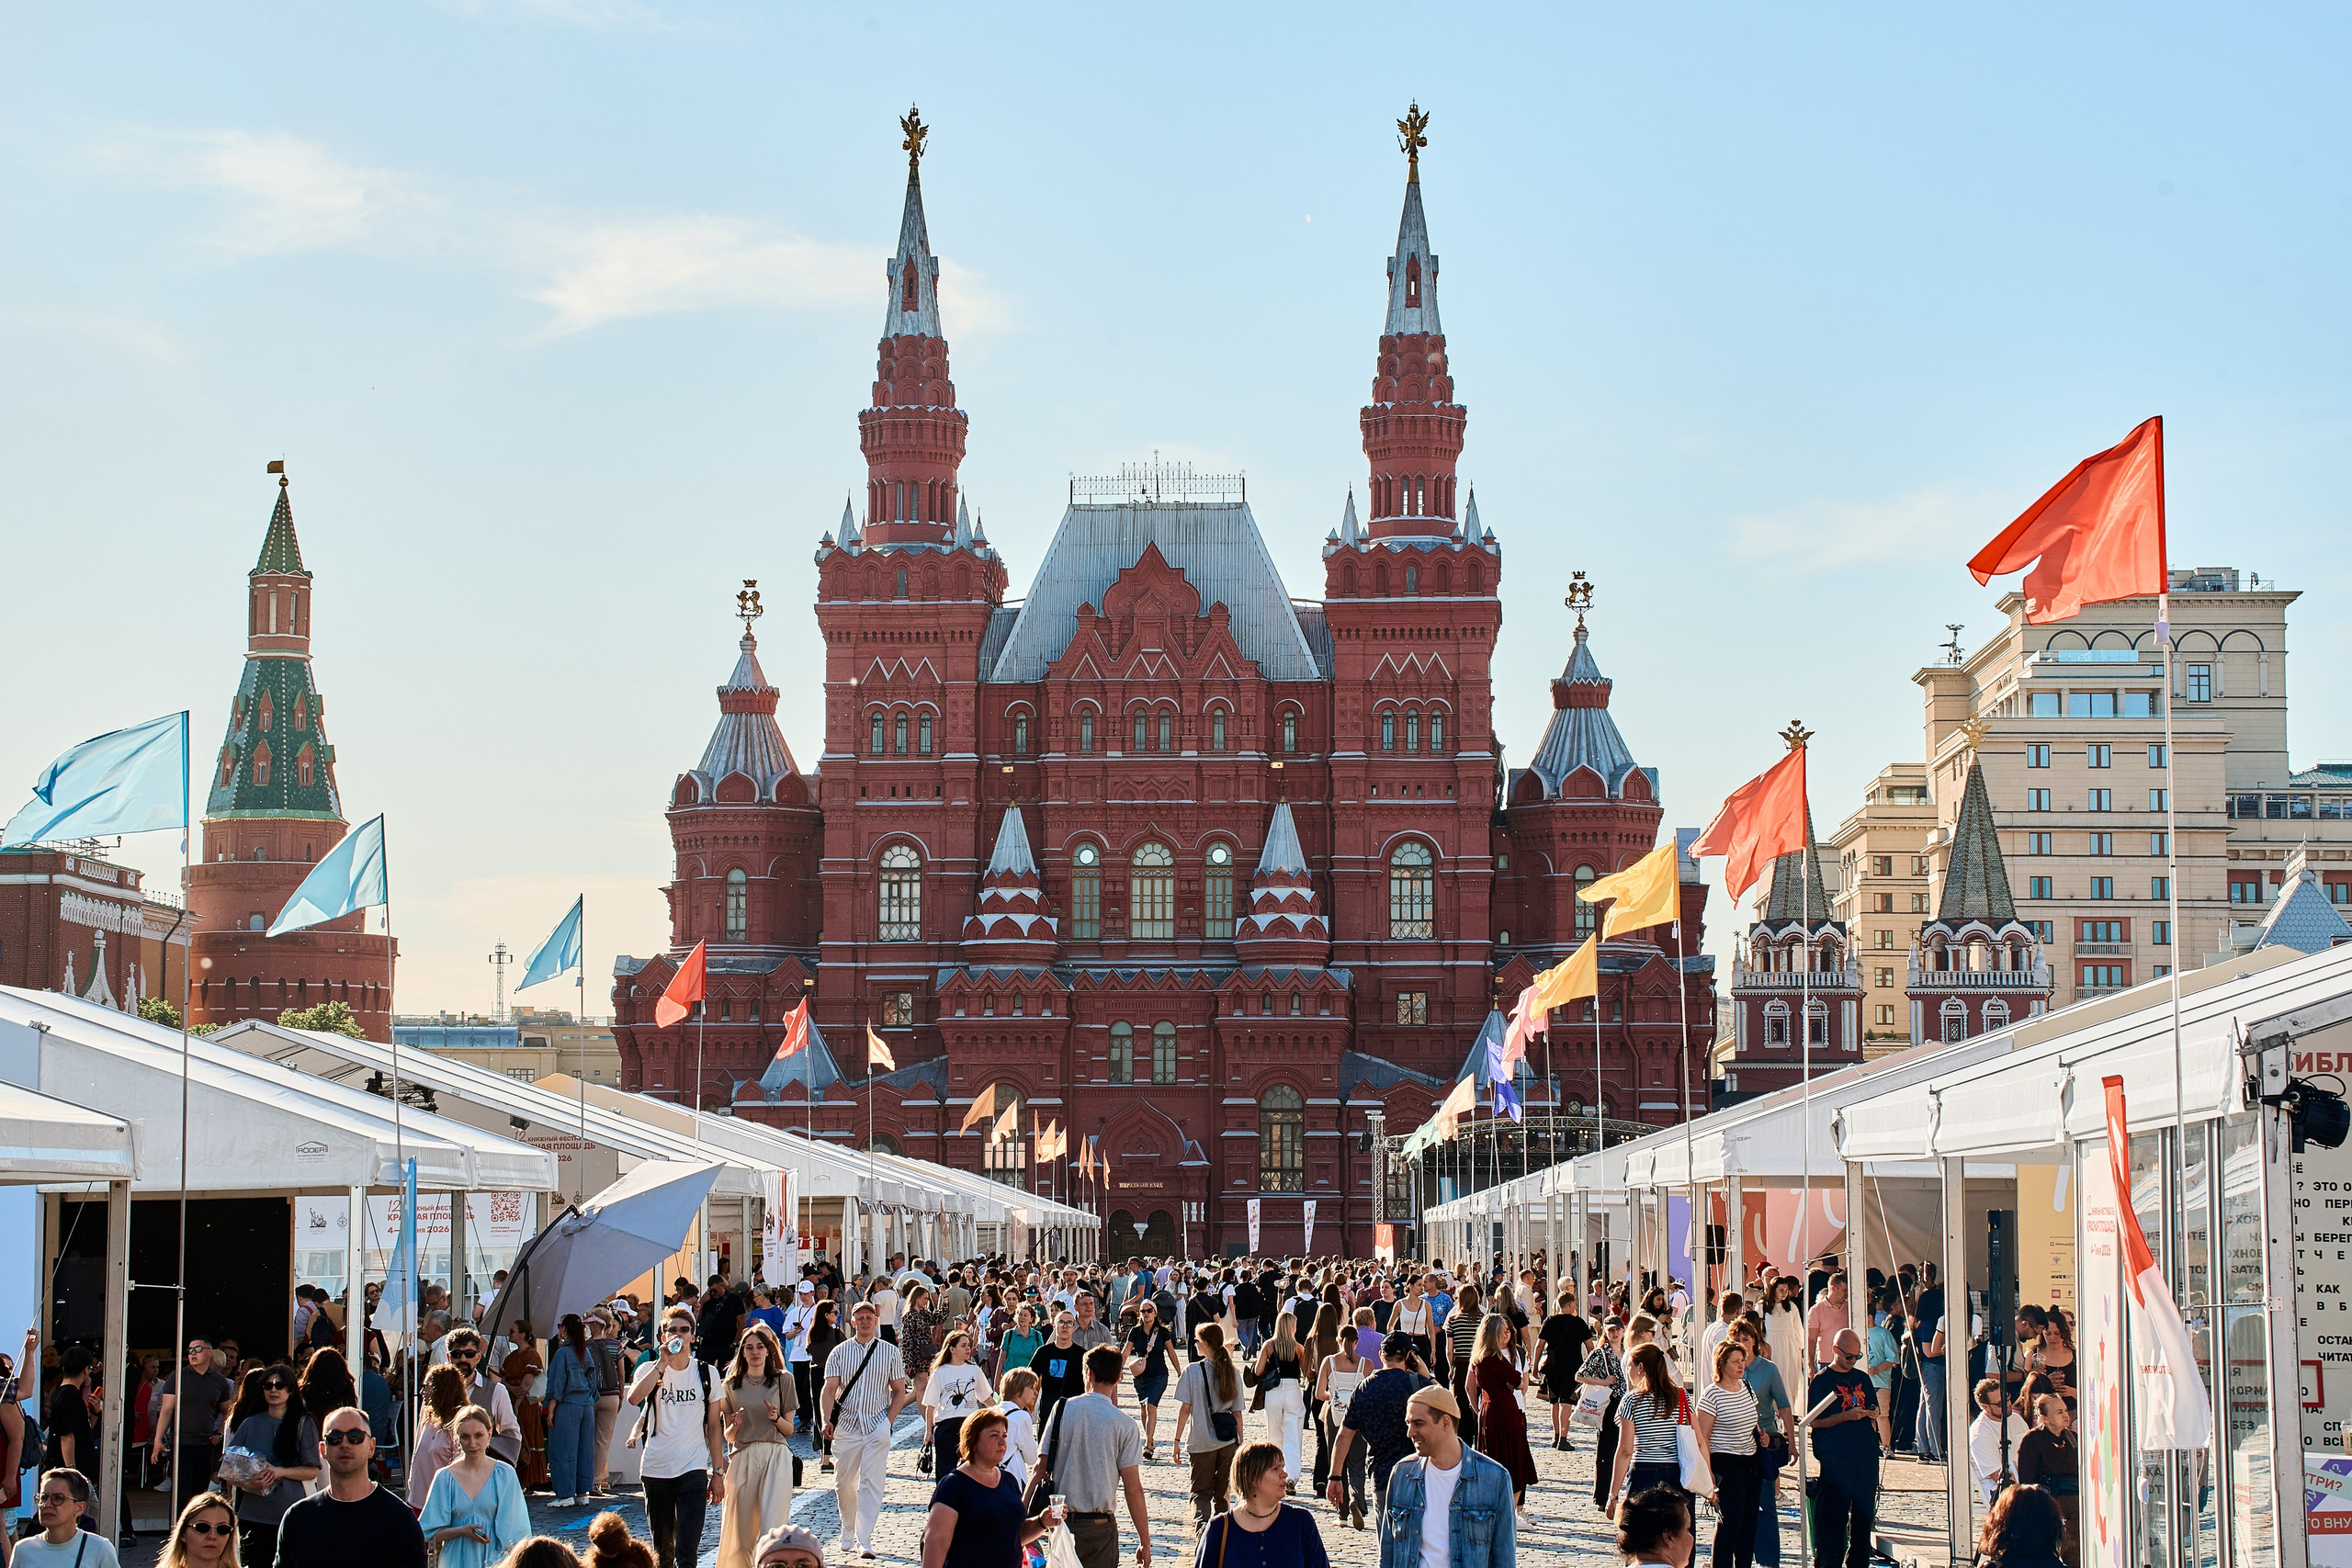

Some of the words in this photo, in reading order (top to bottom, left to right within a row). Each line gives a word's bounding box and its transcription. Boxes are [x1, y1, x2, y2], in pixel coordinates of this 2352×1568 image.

[2290, 1052, 2352, 1073] ИБЛ
[2312, 1181, 2338, 1191] ЭТО
[2324, 1199, 2352, 1209] ПЕР
[2342, 1216, 2352, 1226] К
[426, 1225, 450, 1234] 2026
[2315, 1283, 2341, 1294] КАК
[661, 1383, 696, 1404] PARIS
